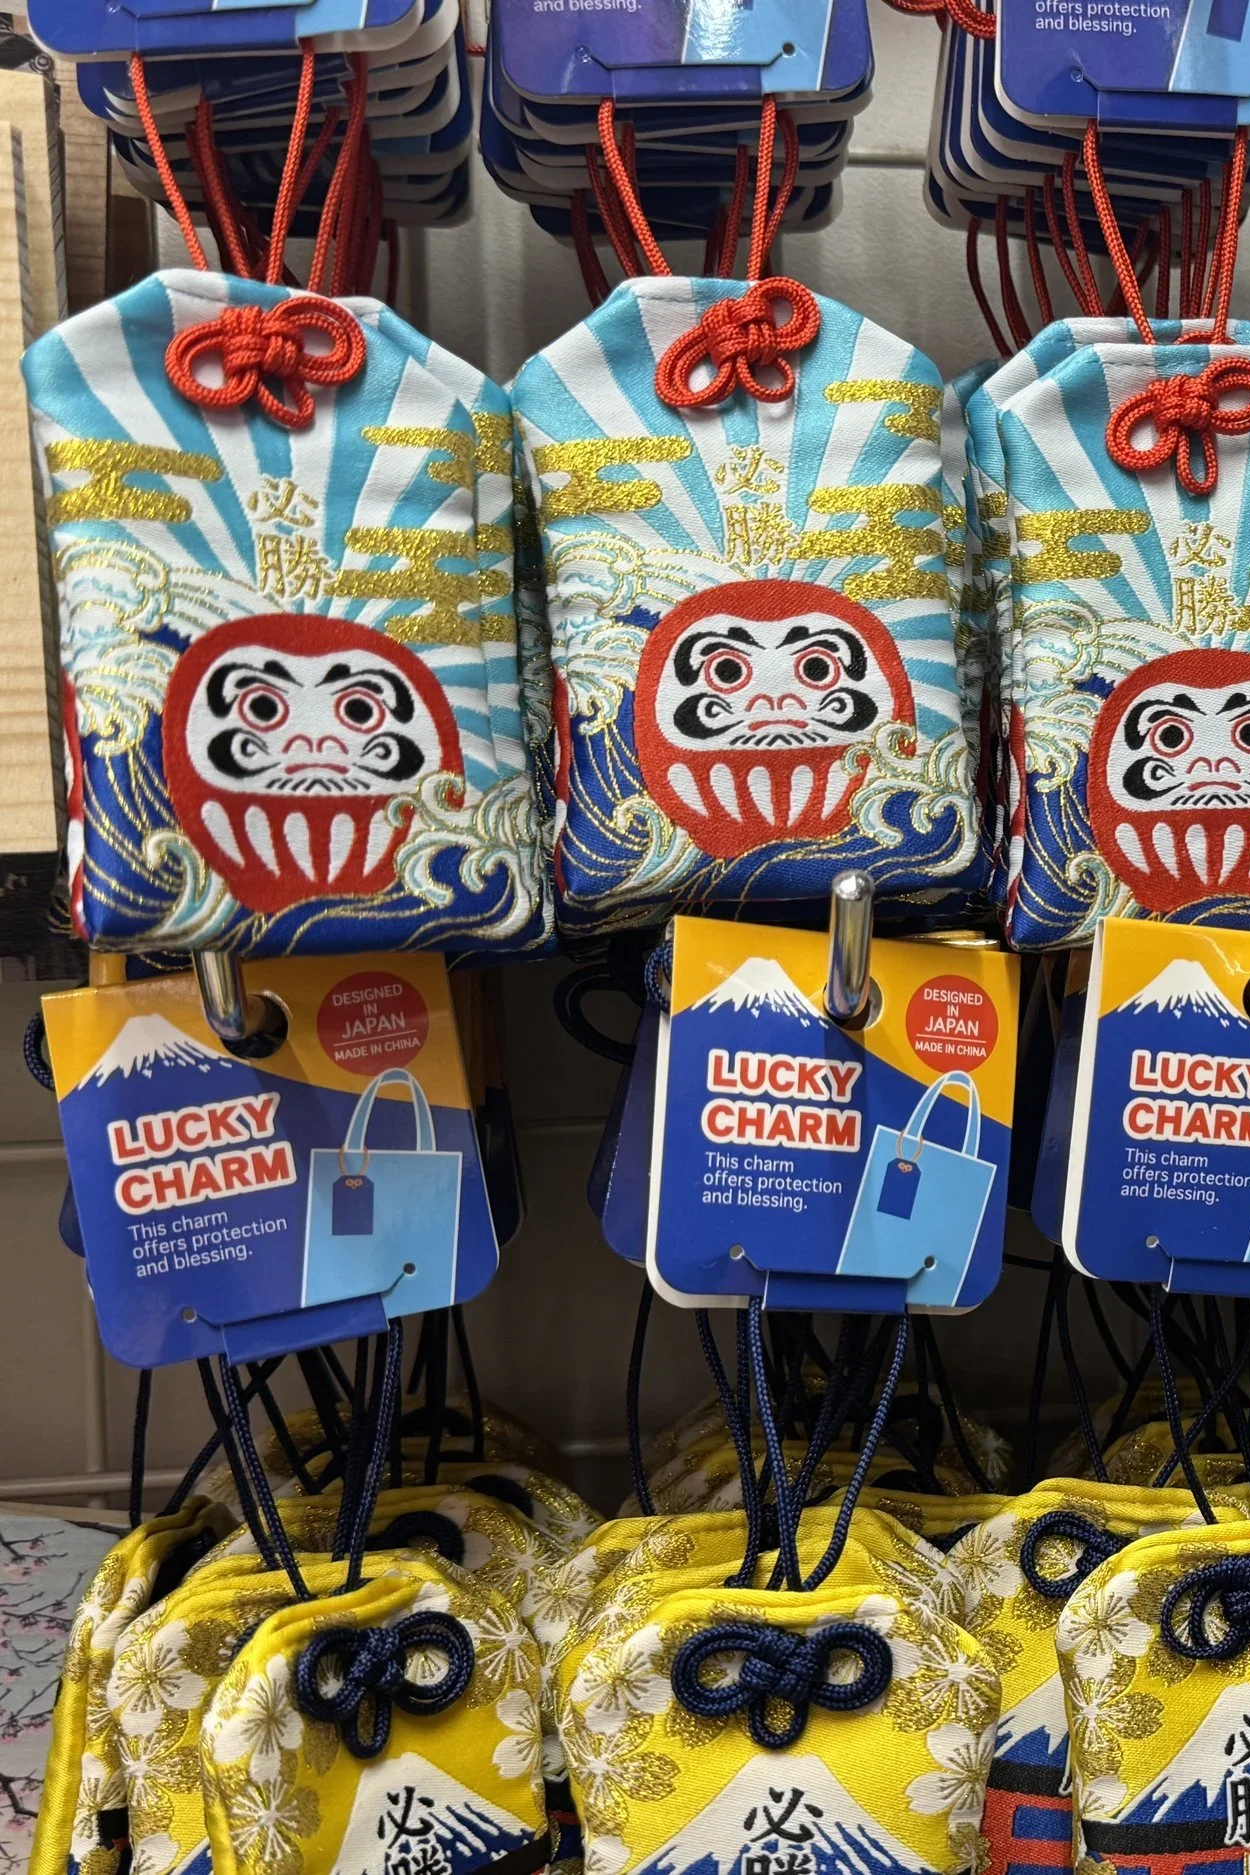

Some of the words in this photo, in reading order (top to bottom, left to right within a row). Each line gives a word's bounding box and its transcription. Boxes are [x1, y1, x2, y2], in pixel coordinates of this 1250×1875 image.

[534, 0, 564, 12] and
[570, 0, 642, 12] blessing.
[1035, 0, 1082, 14] offers
[1088, 1, 1170, 18] protection
[1035, 16, 1063, 30] and
[1069, 17, 1137, 36] blessing.
[332, 984, 403, 1007] DESIGNED
[923, 988, 983, 1006] DESIGNED
[363, 1003, 378, 1016] IN
[947, 1004, 960, 1017] IN
[342, 1011, 406, 1039] JAPAN
[924, 1016, 979, 1037] JAPAN
[334, 1046, 368, 1061] MADE
[370, 1043, 382, 1055] IN
[384, 1037, 421, 1052] CHINA
[915, 1040, 943, 1052] MADE
[945, 1043, 955, 1054] IN
[957, 1044, 987, 1057] CHINA
[710, 1052, 860, 1100] LUCKY
[111, 1095, 277, 1162] LUCKY
[704, 1101, 859, 1149] CHARM
[705, 1152, 739, 1169] This
[744, 1154, 794, 1173] charm
[1125, 1147, 1156, 1164] This
[1161, 1151, 1208, 1168] charm
[118, 1144, 293, 1211] CHARM
[703, 1170, 753, 1188] offers
[758, 1176, 842, 1194] protection
[1122, 1165, 1169, 1182] offers
[702, 1189, 732, 1205] and
[737, 1190, 808, 1213] blessing.
[1120, 1183, 1149, 1198] and
[1153, 1184, 1219, 1205] blessing.
[128, 1223, 167, 1241] This
[172, 1211, 228, 1232] charm
[133, 1238, 187, 1259] offers
[191, 1217, 288, 1248] protection
[136, 1260, 169, 1277] and
[174, 1244, 253, 1270] blessing.
